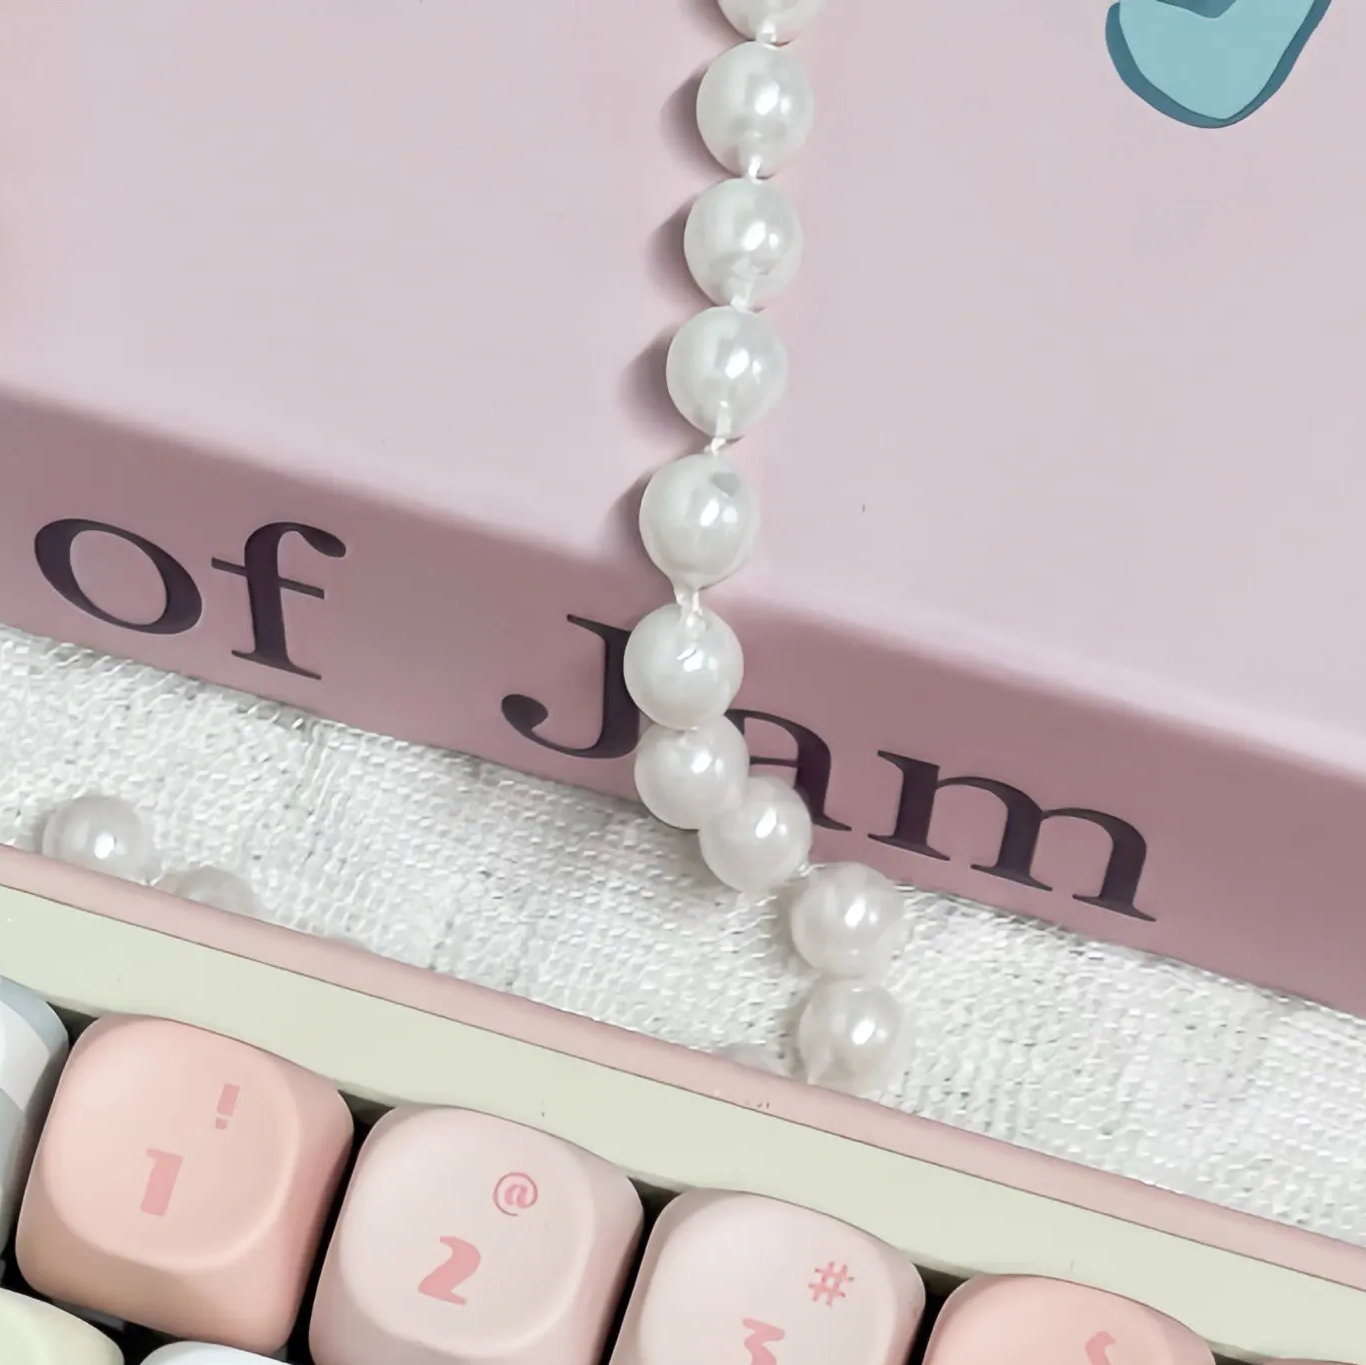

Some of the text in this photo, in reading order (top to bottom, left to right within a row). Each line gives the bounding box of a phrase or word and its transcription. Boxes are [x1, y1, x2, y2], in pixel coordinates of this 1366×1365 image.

[33, 518, 347, 681] of
[214, 1082, 241, 1130] !
[140, 1147, 183, 1217] 1
[492, 1171, 539, 1217] @
[418, 1235, 482, 1306] 2
[808, 1260, 855, 1307] #
